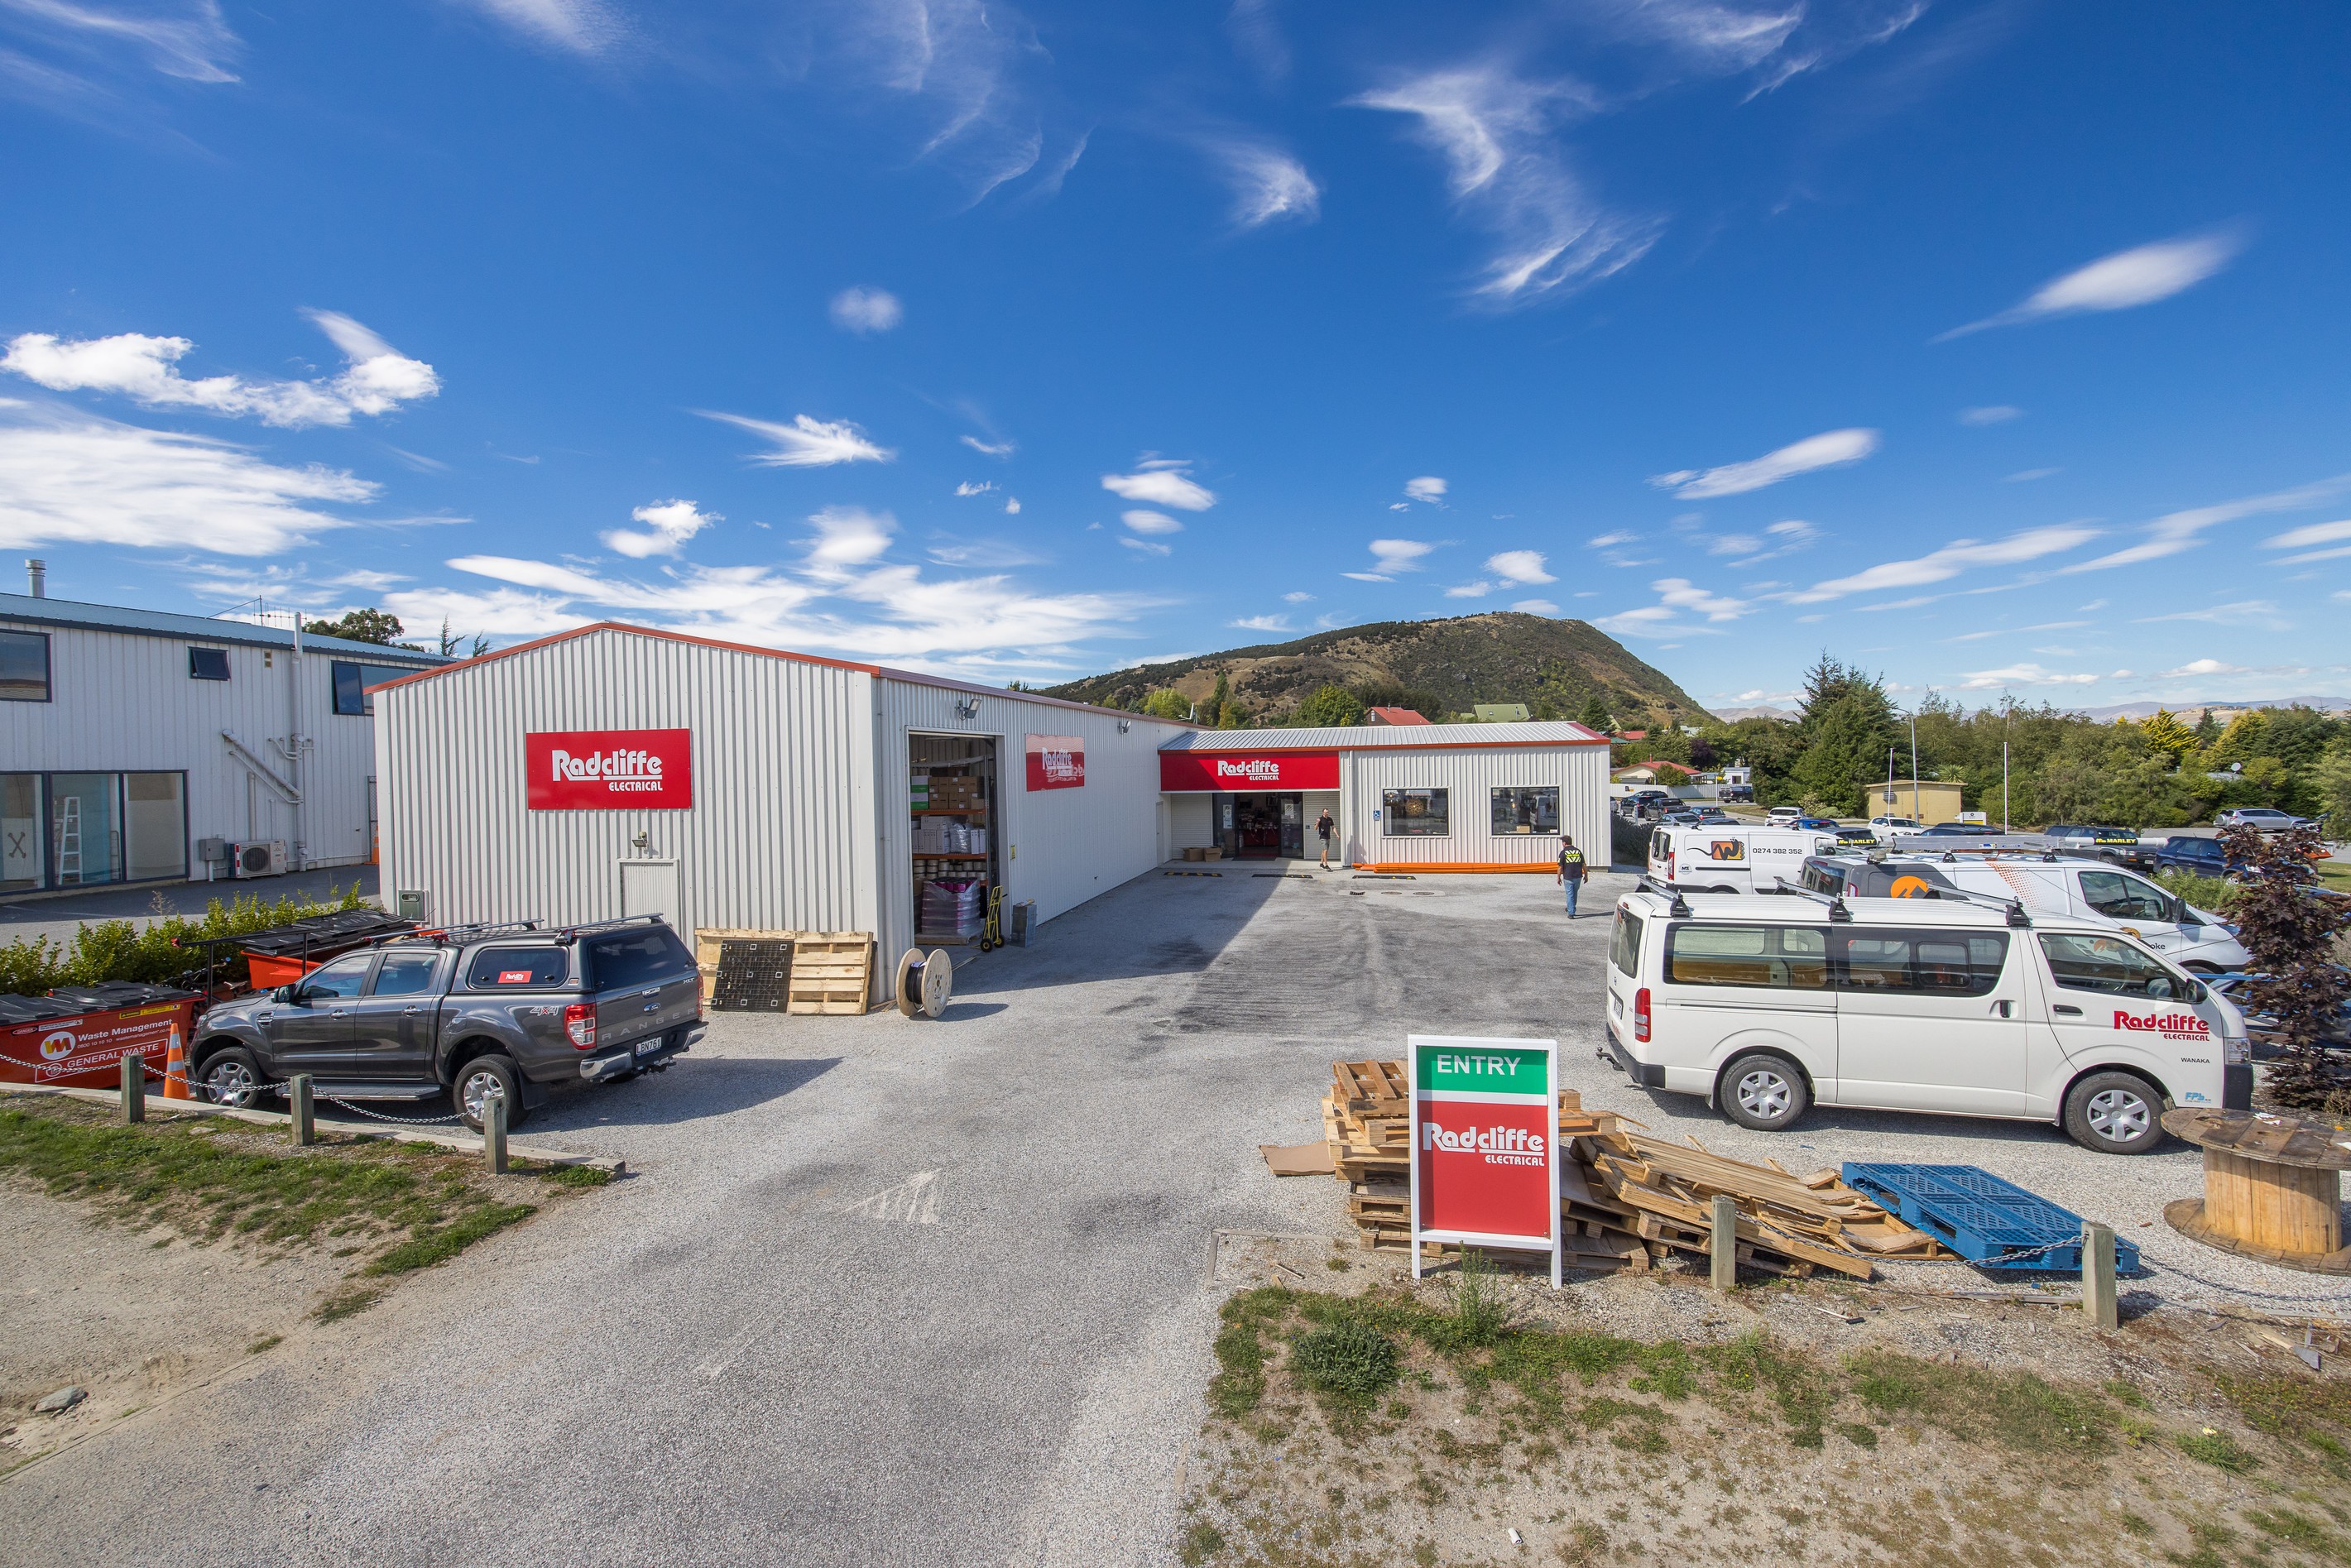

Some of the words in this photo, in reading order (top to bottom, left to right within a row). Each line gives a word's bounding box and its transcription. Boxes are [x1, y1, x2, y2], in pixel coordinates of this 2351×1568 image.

[552, 748, 663, 781] Radcliffe
[1042, 747, 1072, 770] Radcliffe
[1217, 760, 1279, 776] Radcliffe
[608, 781, 663, 792] ELECTRICAL
[78, 1031, 109, 1042] Waste
[111, 1019, 172, 1036] Management
[601, 1007, 696, 1041] RANGER
[2114, 1010, 2209, 1034] Radcliffe
[636, 1038, 662, 1054] LBN761
[2163, 1033, 2210, 1042] ELECTRICAL
[67, 1052, 120, 1068] GENERAL
[122, 1043, 160, 1057] WASTE
[1437, 1054, 1522, 1076] ENTRY
[1423, 1122, 1545, 1157] Radcliffe
[1485, 1154, 1545, 1167] ELECTRICAL
